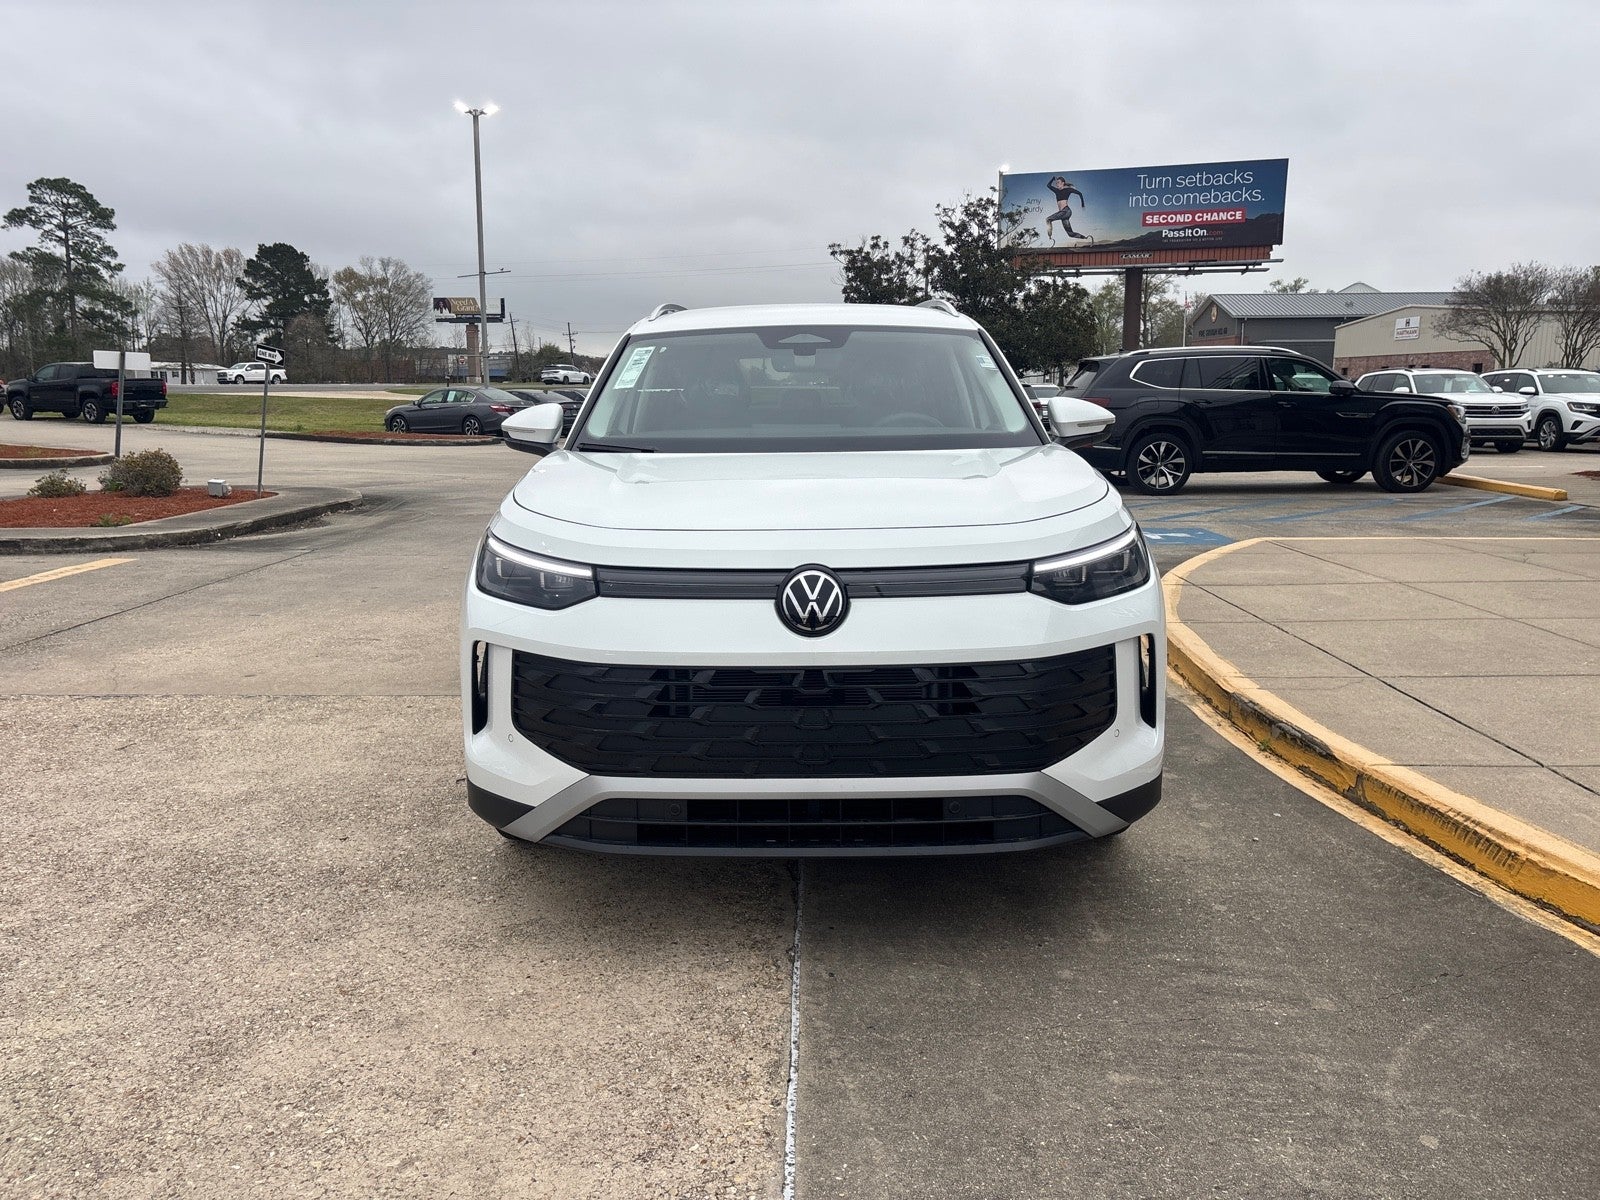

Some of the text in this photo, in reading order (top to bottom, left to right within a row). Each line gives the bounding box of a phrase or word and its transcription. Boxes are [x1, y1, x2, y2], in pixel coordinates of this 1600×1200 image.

[1137, 169, 1254, 189] Turn setbacks
[1026, 198, 1041, 206] Amy
[1129, 187, 1265, 207] into comebacks.
[1145, 211, 1243, 224] SECOND CHANCE
[450, 298, 474, 306] Need A
[258, 349, 277, 360] ONE WAY
